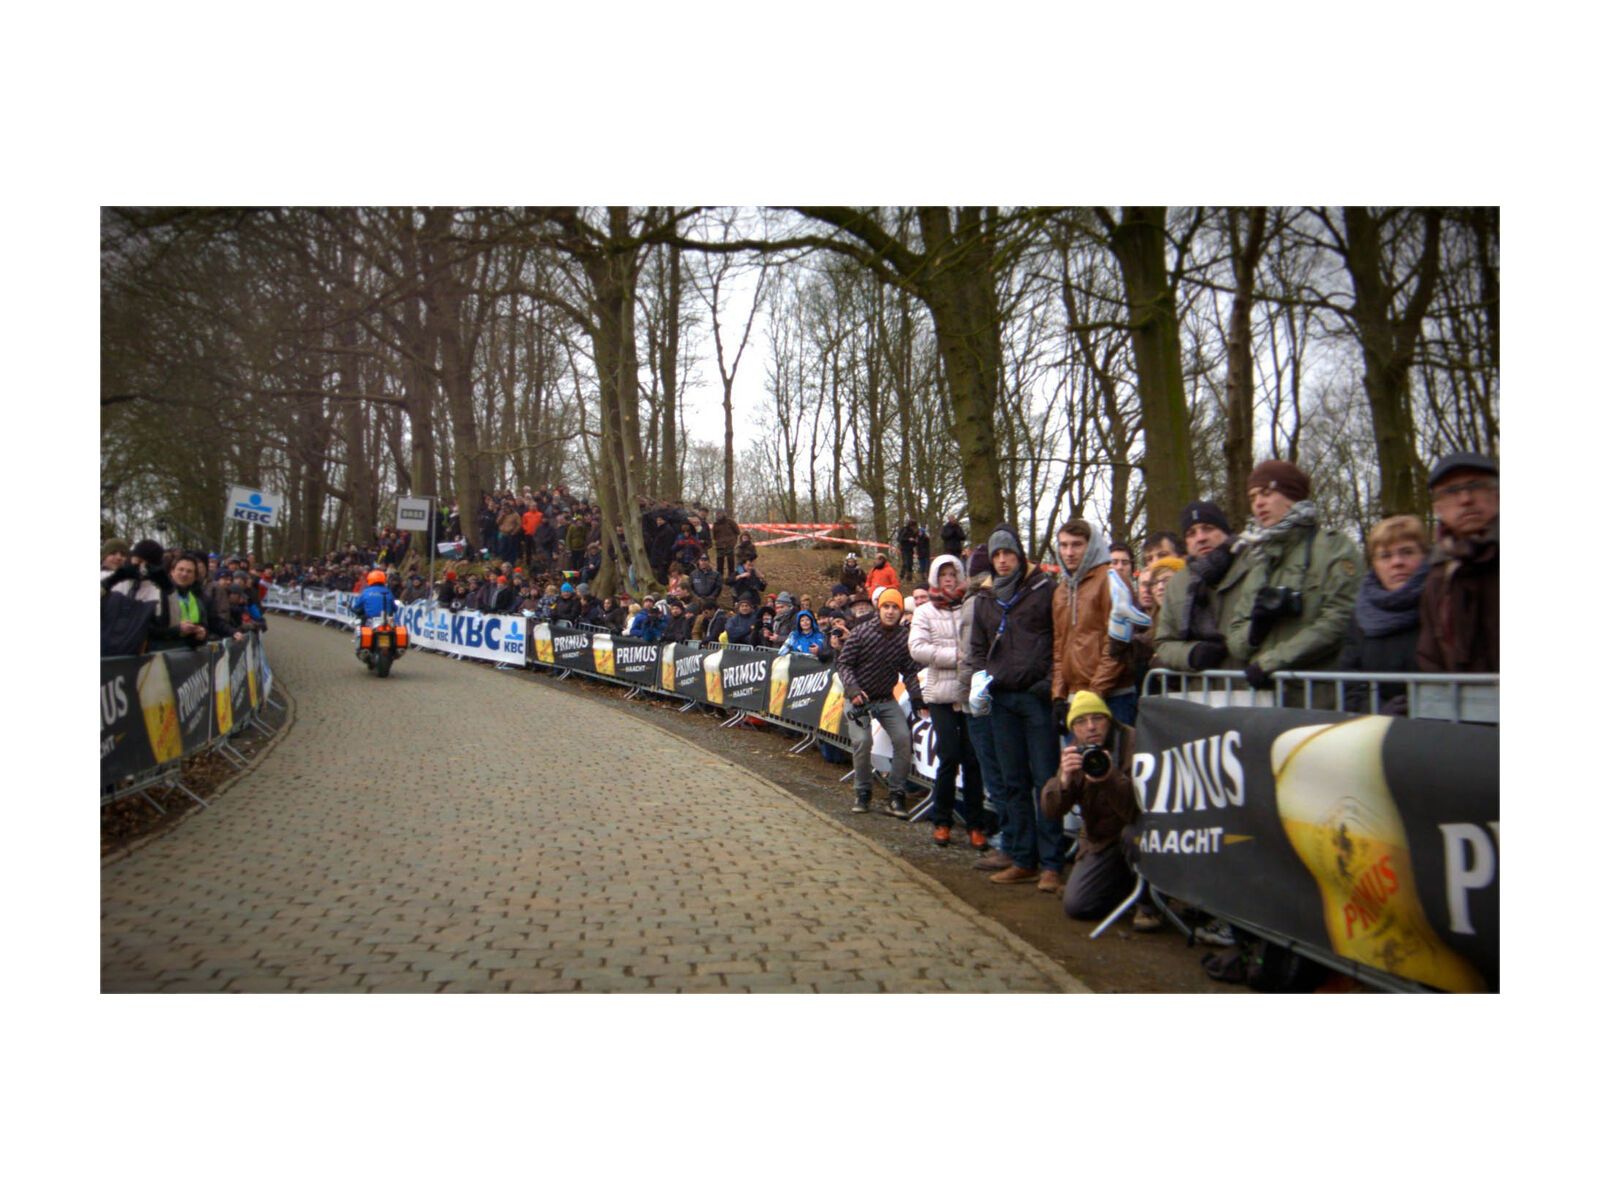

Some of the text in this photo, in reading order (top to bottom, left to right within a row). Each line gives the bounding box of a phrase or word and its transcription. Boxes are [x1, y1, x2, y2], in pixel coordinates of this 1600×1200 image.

[233, 508, 271, 524] KBC
[451, 614, 502, 650] KBC
[554, 633, 589, 652] PRIMUS
[504, 641, 524, 654] KBC
[616, 645, 658, 664] PRIMUS
[723, 660, 767, 689] PRIMUS
[787, 668, 831, 699] PRIMUS
[101, 675, 129, 727] US
[1131, 730, 1245, 814] RIMUS
[1438, 821, 1499, 935] P
